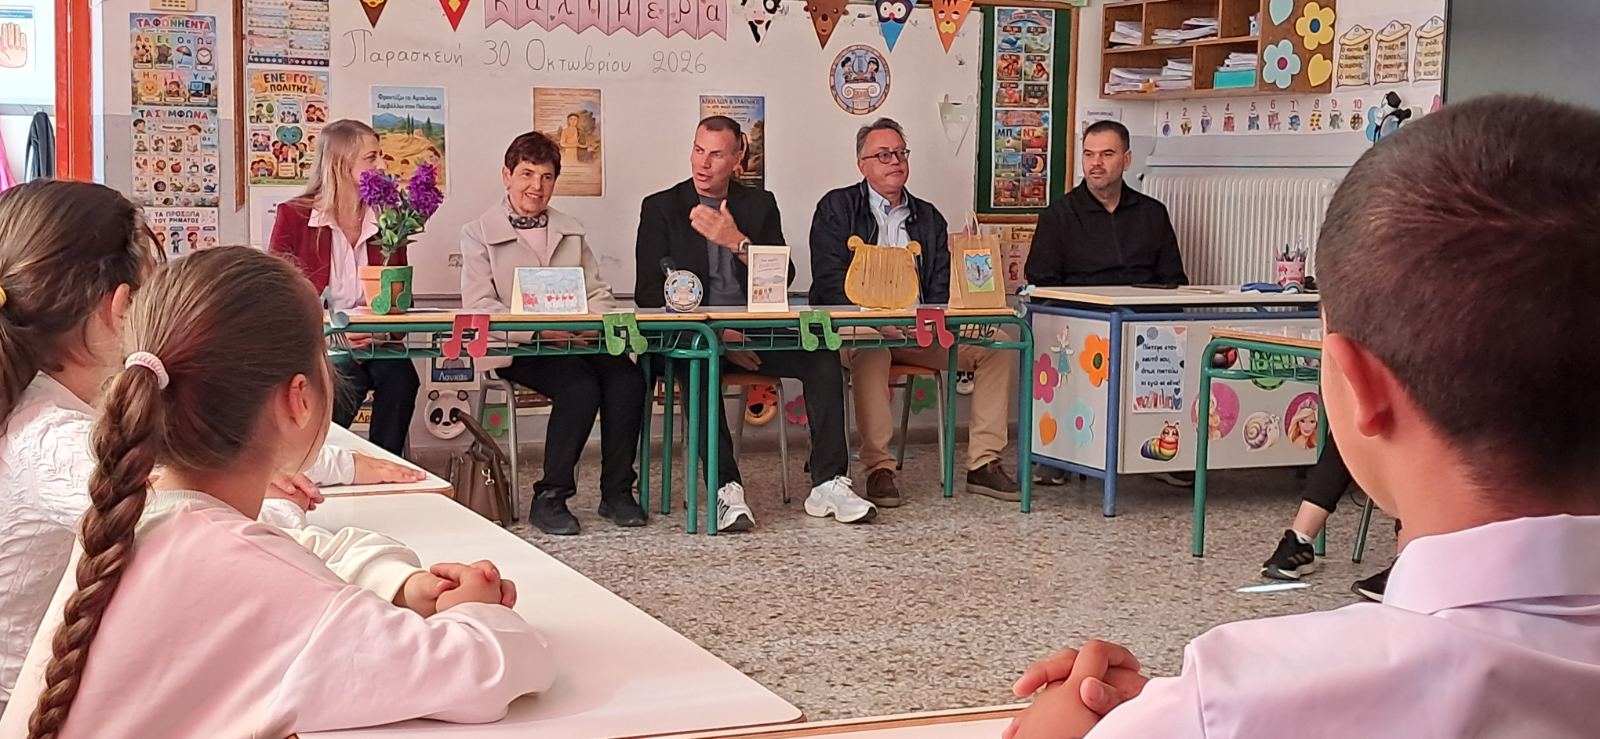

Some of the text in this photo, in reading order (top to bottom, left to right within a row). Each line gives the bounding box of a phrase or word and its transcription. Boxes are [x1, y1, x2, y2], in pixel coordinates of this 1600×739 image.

[136, 19, 210, 30] ΤΑ ΦΩΝΗΕΝΤΑ
[343, 29, 707, 74] Παρασκευή 30 Οκτωβρίου 2026
[263, 73, 314, 85] ΕΝΕΡΓΟΣ
[270, 84, 308, 93] ΠΟΛΙΤΗΣ
[1182, 107, 1187, 116] 2
[1202, 105, 1207, 114] 3
[1225, 103, 1230, 111] 4
[1250, 102, 1256, 111] 5
[1270, 100, 1276, 109] 6
[1290, 100, 1295, 110] 7
[1314, 99, 1320, 109] 8
[1331, 99, 1337, 108] 9
[1353, 99, 1362, 109] 10
[139, 110, 209, 120] ΤΑ ΣΥΜΦΩΝΑ
[1023, 129, 1035, 137] ΝΤ
